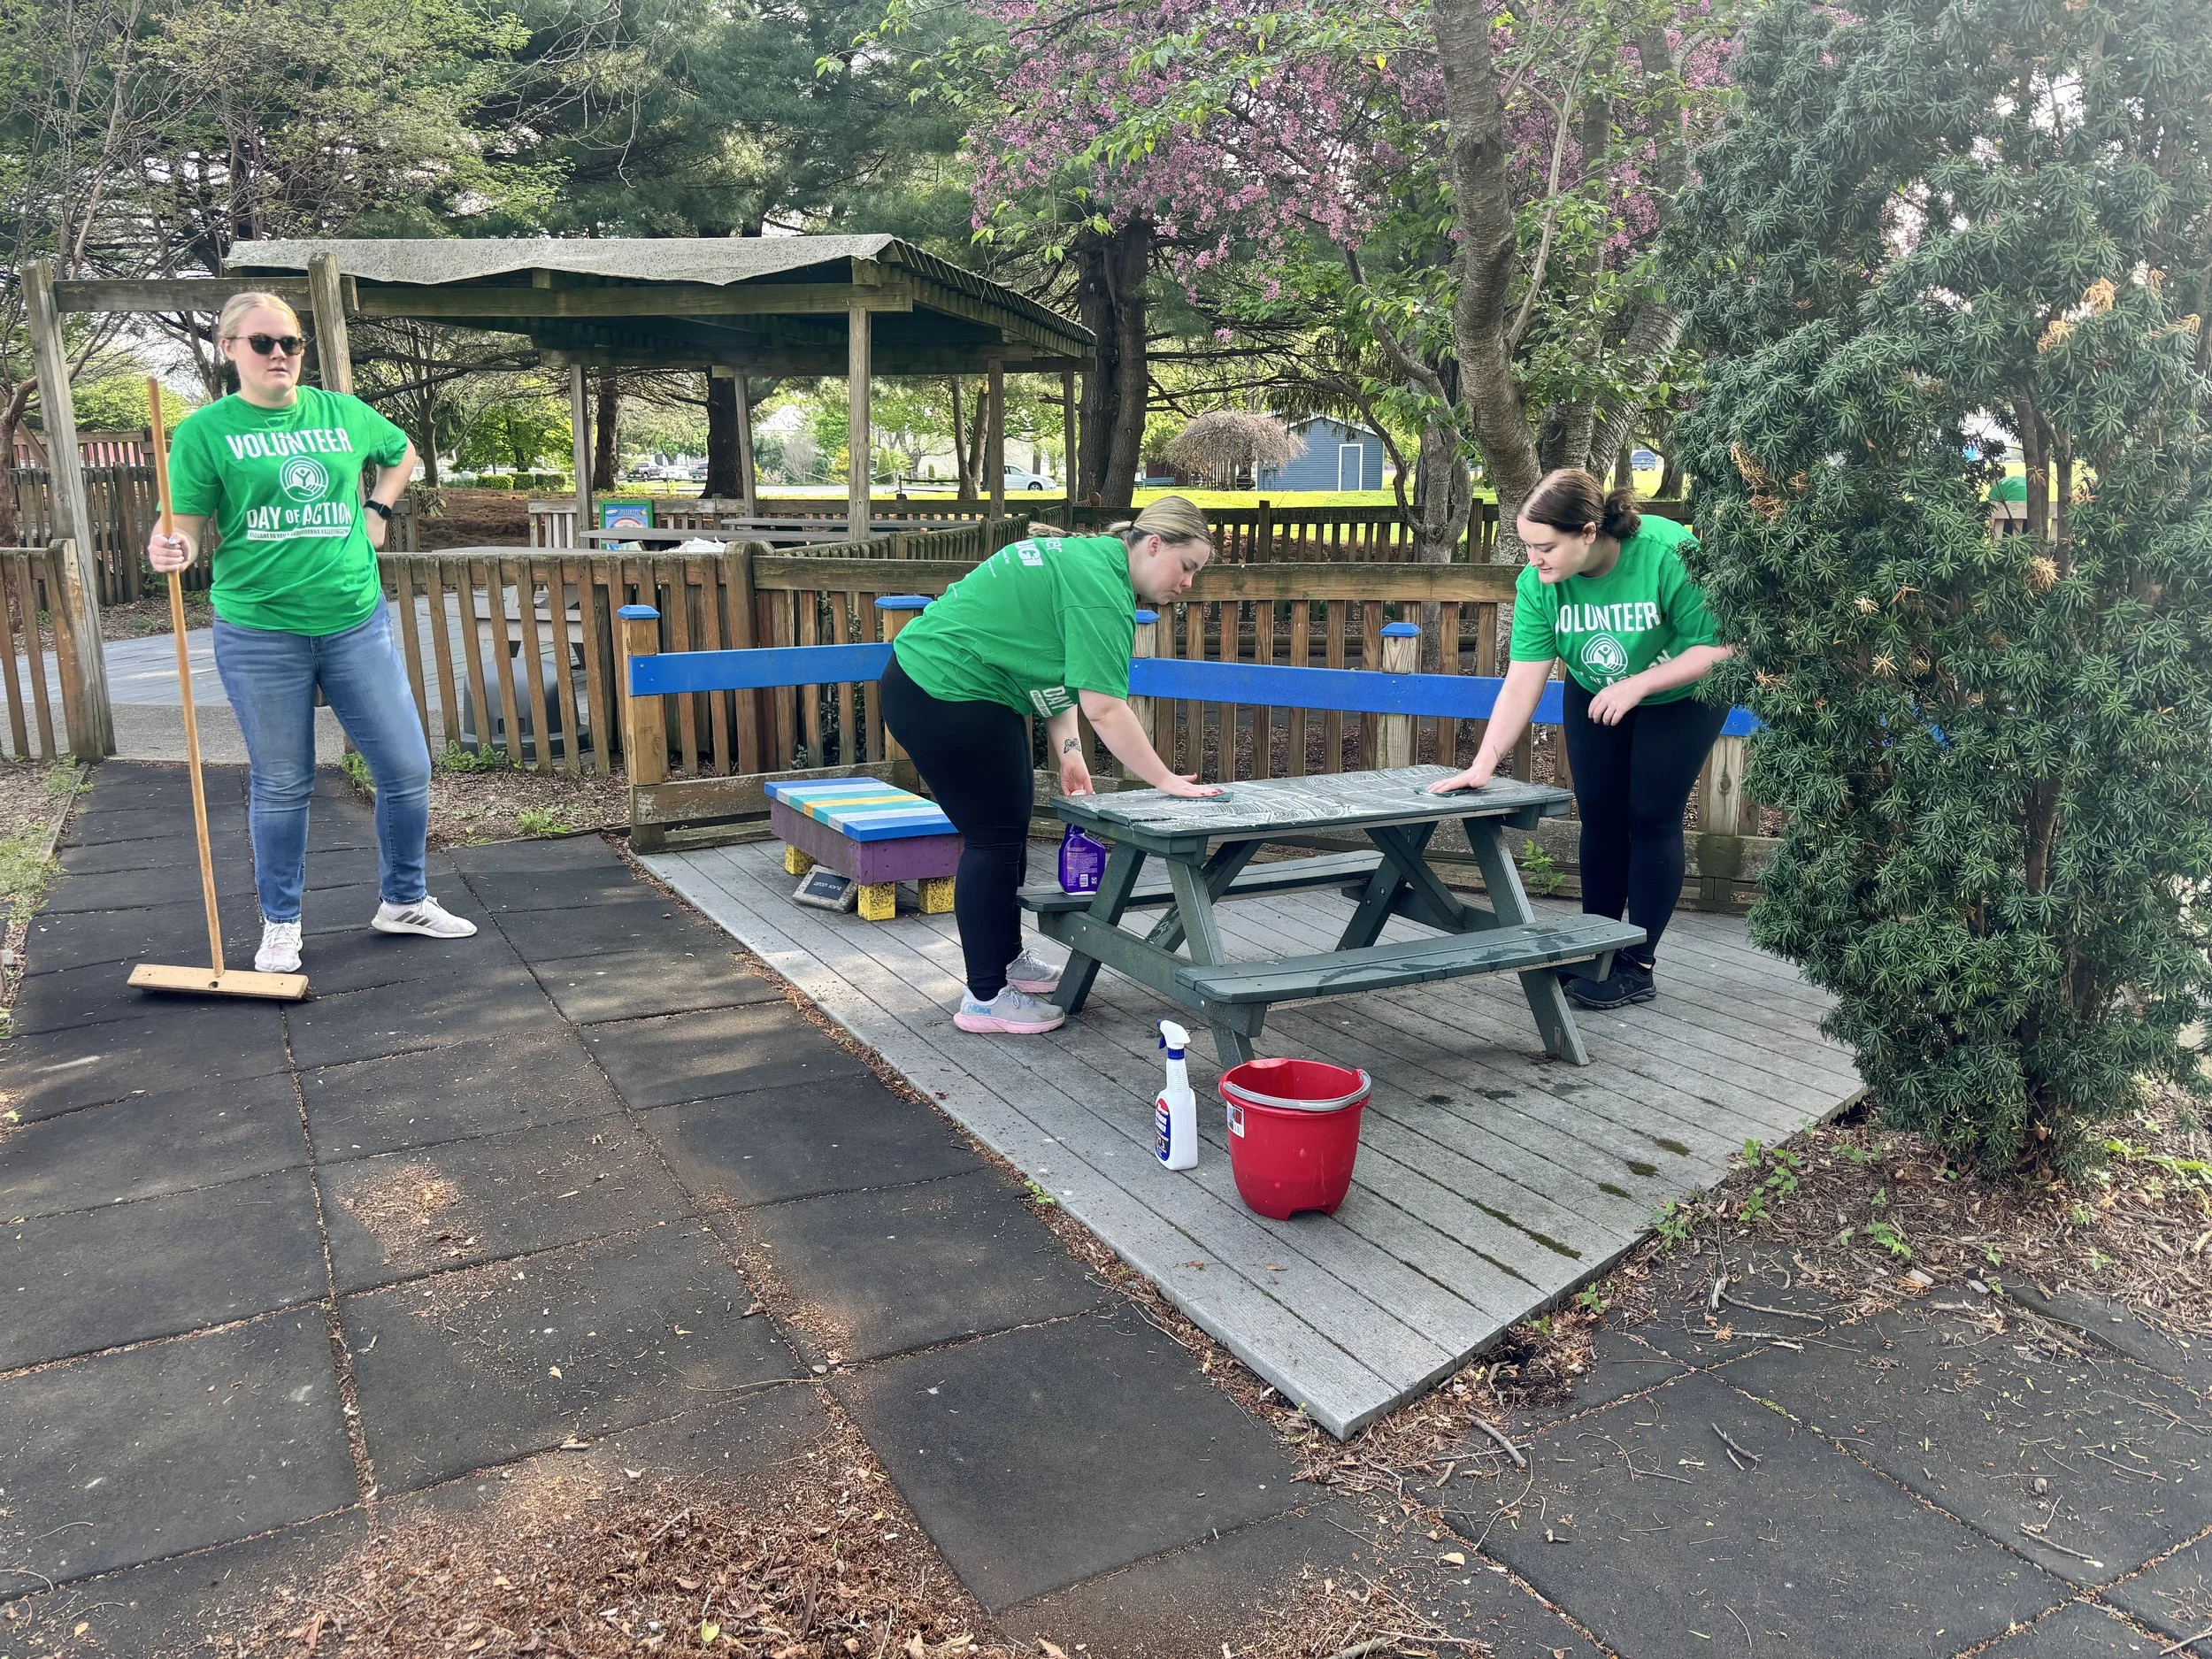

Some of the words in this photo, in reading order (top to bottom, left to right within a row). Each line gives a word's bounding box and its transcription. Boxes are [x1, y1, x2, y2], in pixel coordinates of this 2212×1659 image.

[225, 427, 353, 460] VOLUNTEER
[247, 506, 281, 530] DAY
[286, 509, 300, 524] OF
[1042, 685, 1074, 710] DAY
